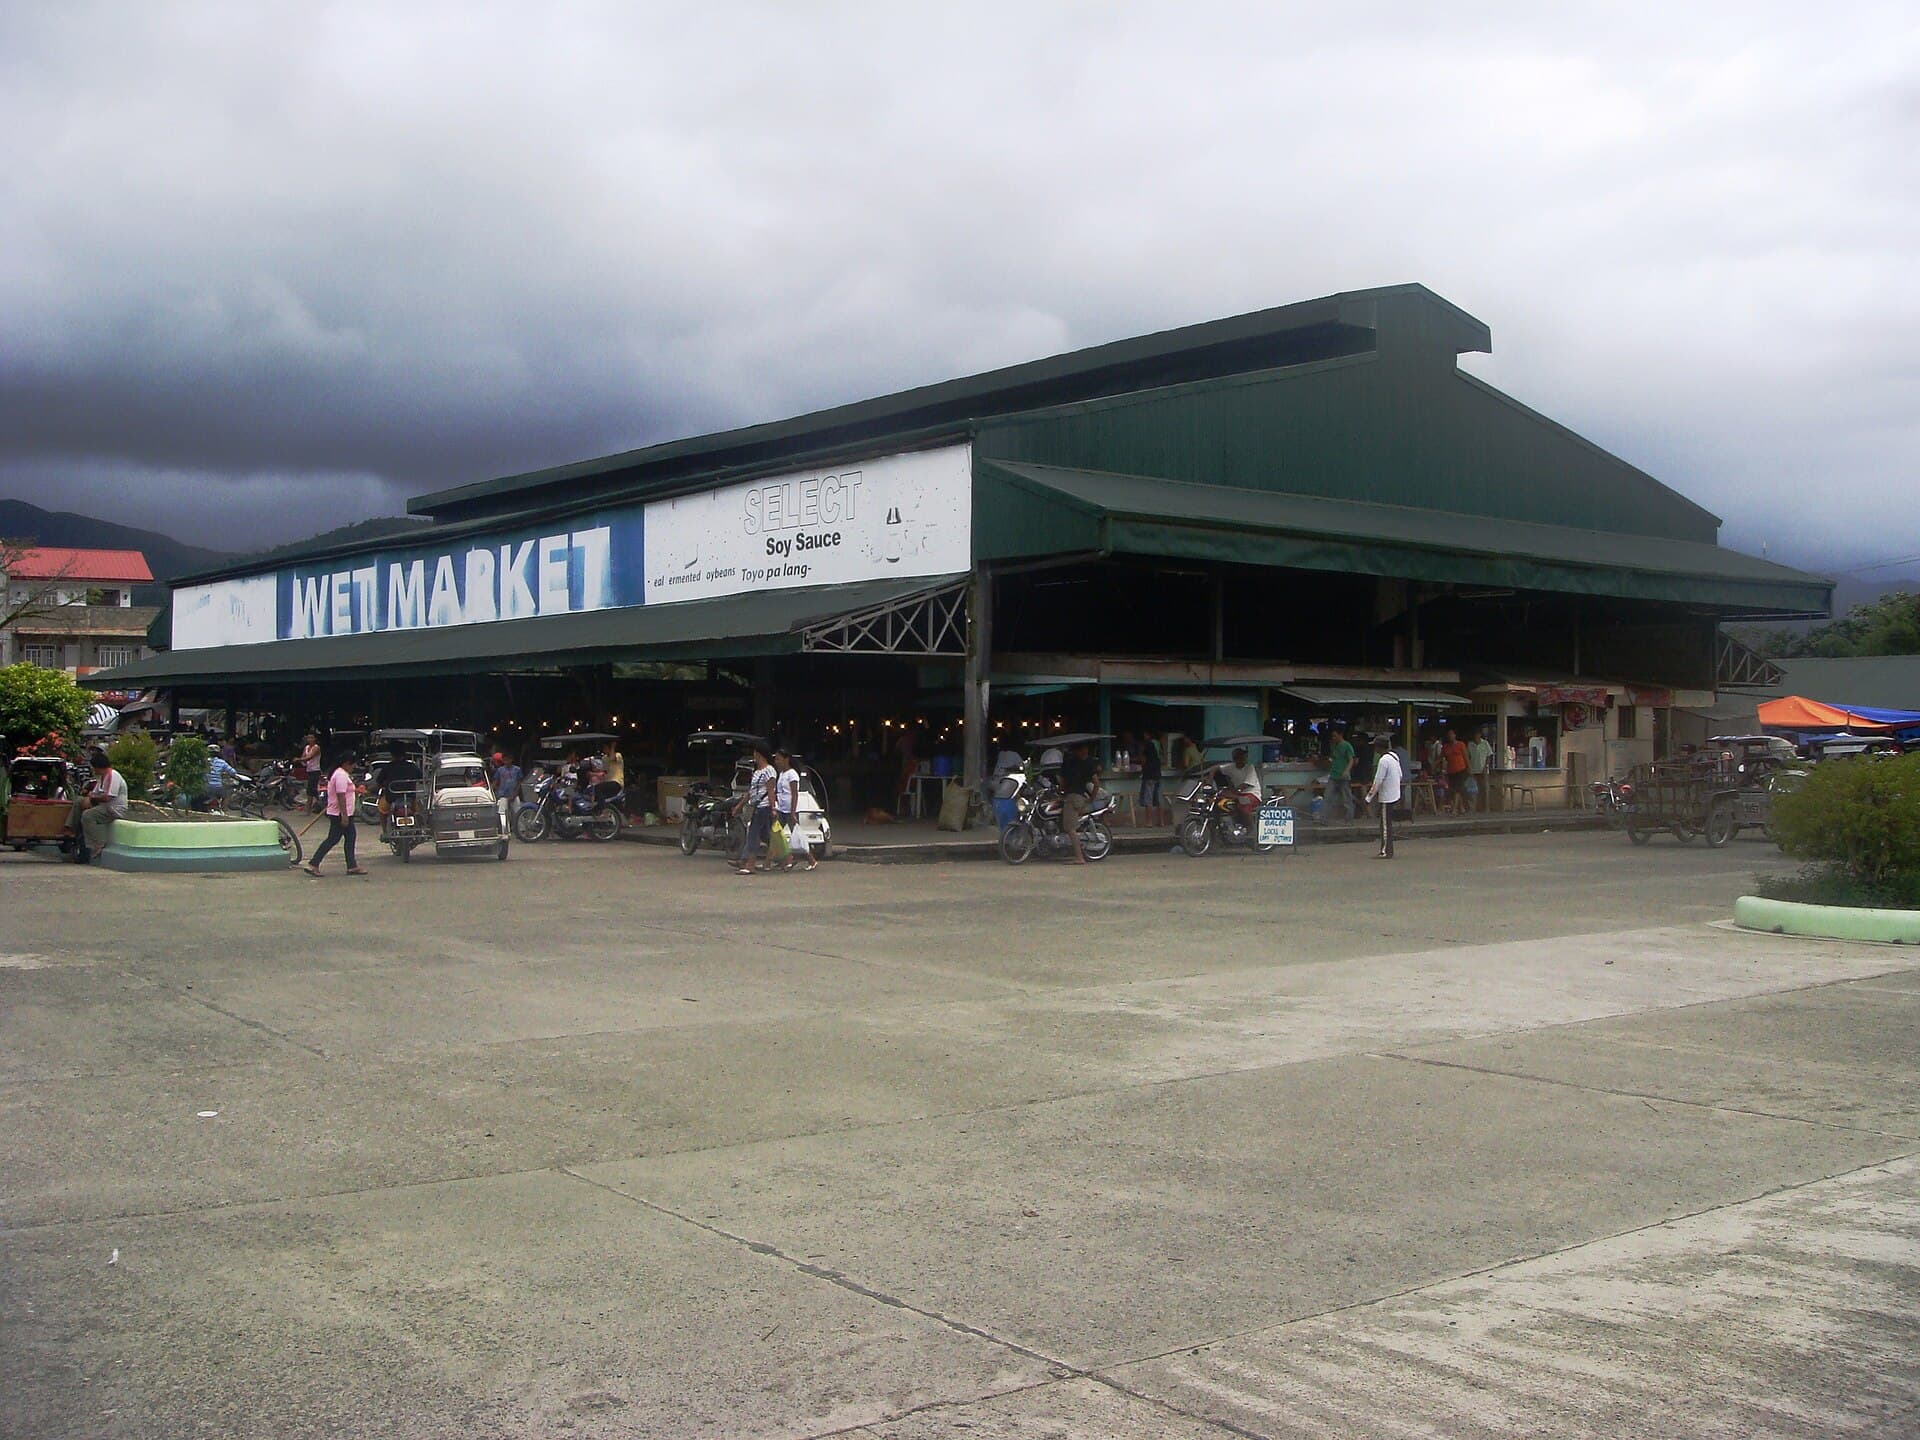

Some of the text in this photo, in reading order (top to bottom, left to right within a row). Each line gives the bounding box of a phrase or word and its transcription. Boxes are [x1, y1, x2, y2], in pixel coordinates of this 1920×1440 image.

[744, 471, 863, 535] SELECT
[766, 532, 841, 557] Soy Sauce
[290, 567, 377, 638] WET
[387, 526, 611, 629] MARKET
[741, 567, 765, 582] Toyo
[766, 567, 781, 580] pa
